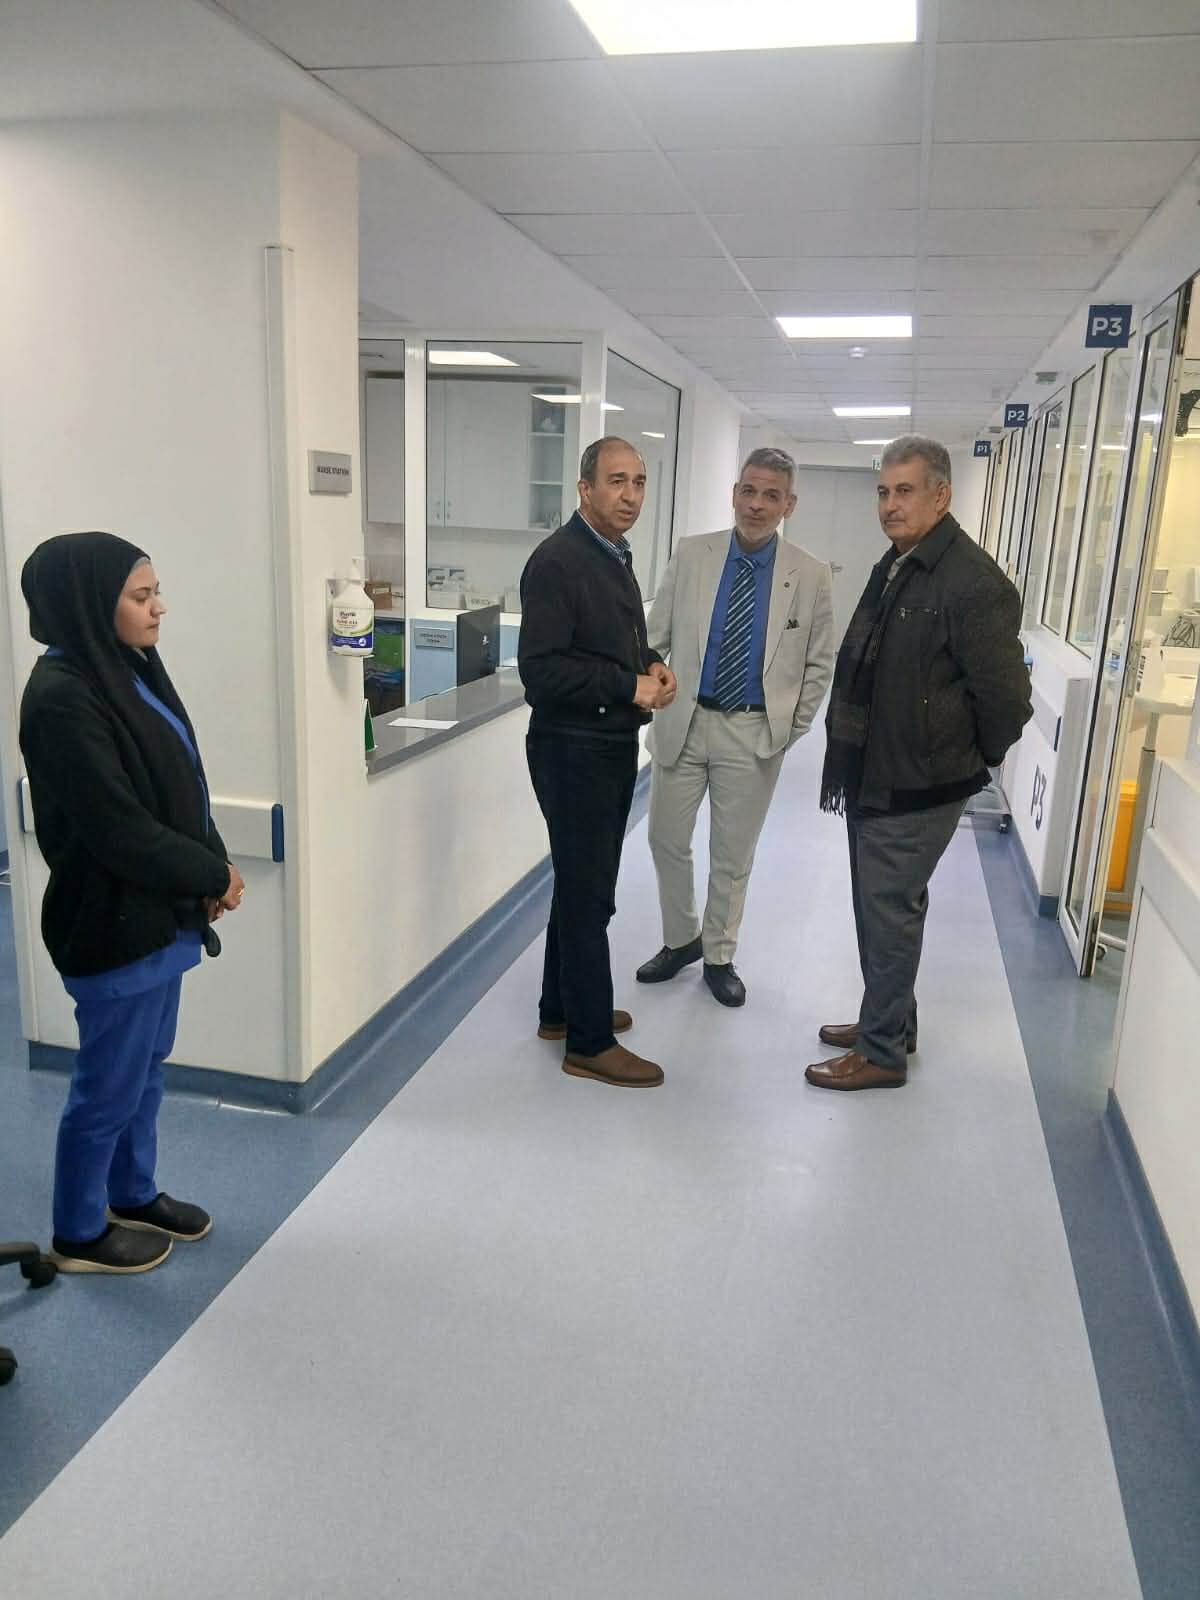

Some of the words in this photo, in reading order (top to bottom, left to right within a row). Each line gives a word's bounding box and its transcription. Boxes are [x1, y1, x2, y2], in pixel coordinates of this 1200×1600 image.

[1091, 317, 1123, 337] P3
[1007, 410, 1026, 422] P2
[977, 445, 988, 454] P1
[1031, 764, 1047, 831] P3
